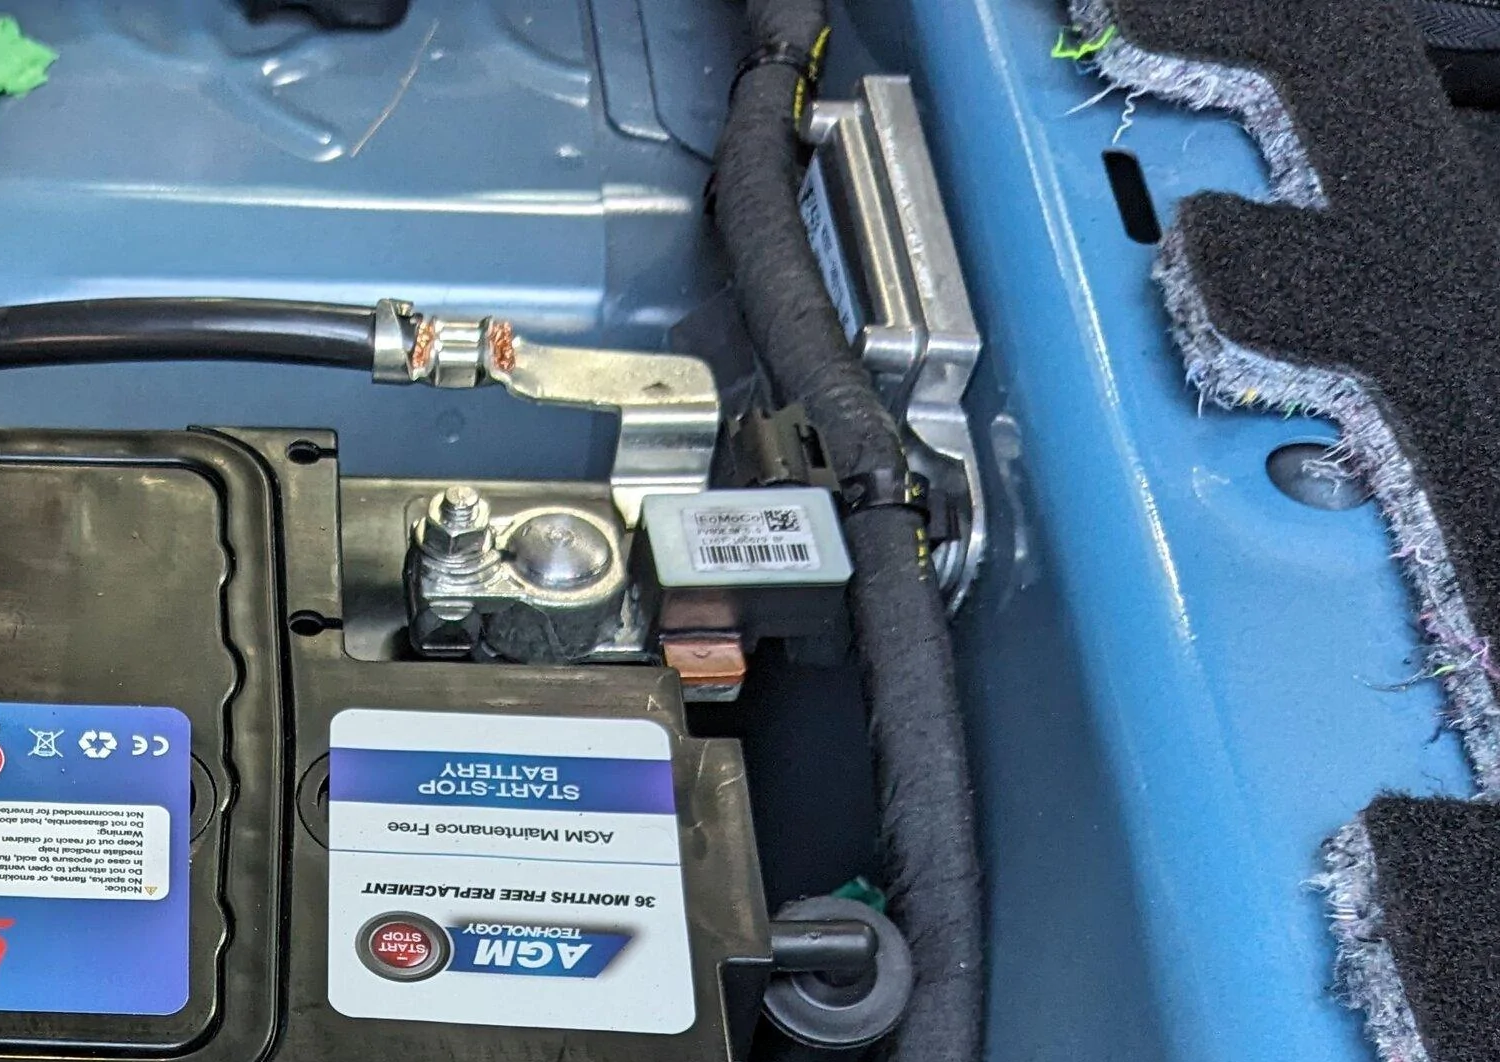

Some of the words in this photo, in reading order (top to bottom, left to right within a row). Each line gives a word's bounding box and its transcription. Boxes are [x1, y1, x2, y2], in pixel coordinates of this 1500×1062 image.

[439, 762, 558, 781] BATTERY
[418, 780, 581, 800] START-STOP
[36, 808, 50, 816] for
[52, 809, 124, 818] recommended
[126, 811, 144, 819] Not
[20, 817, 42, 826] heat
[44, 817, 109, 827] disassemble,
[111, 820, 127, 828] not
[129, 820, 144, 828] Do
[97, 827, 143, 838] Warning:
[387, 821, 430, 836] Free
[435, 823, 559, 842] Maintenance
[1, 836, 41, 844] children
[43, 837, 54, 845] of
[565, 829, 614, 844] AGM
[56, 837, 84, 846] reach
[85, 838, 96, 846] of
[98, 838, 115, 847] out
[117, 837, 143, 847] Keep
[37, 845, 60, 855] help
[61, 847, 101, 856] medical
[103, 848, 143, 857] mediate
[13, 854, 38, 863] acid,
[40, 856, 50, 864] to
[52, 854, 93, 863] eposure
[94, 857, 105, 865] of
[133, 858, 143, 866] In
[27, 863, 53, 871] open
[55, 865, 66, 873] to
[68, 864, 107, 874] attempt
[109, 867, 126, 875] not
[128, 867, 142, 875] Do
[50, 874, 87, 883] flames,
[89, 874, 125, 885] sparks,
[128, 877, 142, 885] No
[104, 885, 142, 893] Notice:
[361, 882, 496, 900] REPLACEMENT
[500, 889, 547, 903] FREE
[551, 891, 630, 906] MONTHS
[634, 895, 656, 908] 36
[462, 922, 582, 940] TECHNOLOGY
[382, 931, 422, 943] STOP
[378, 941, 426, 954] START
[472, 939, 592, 970] AGM
